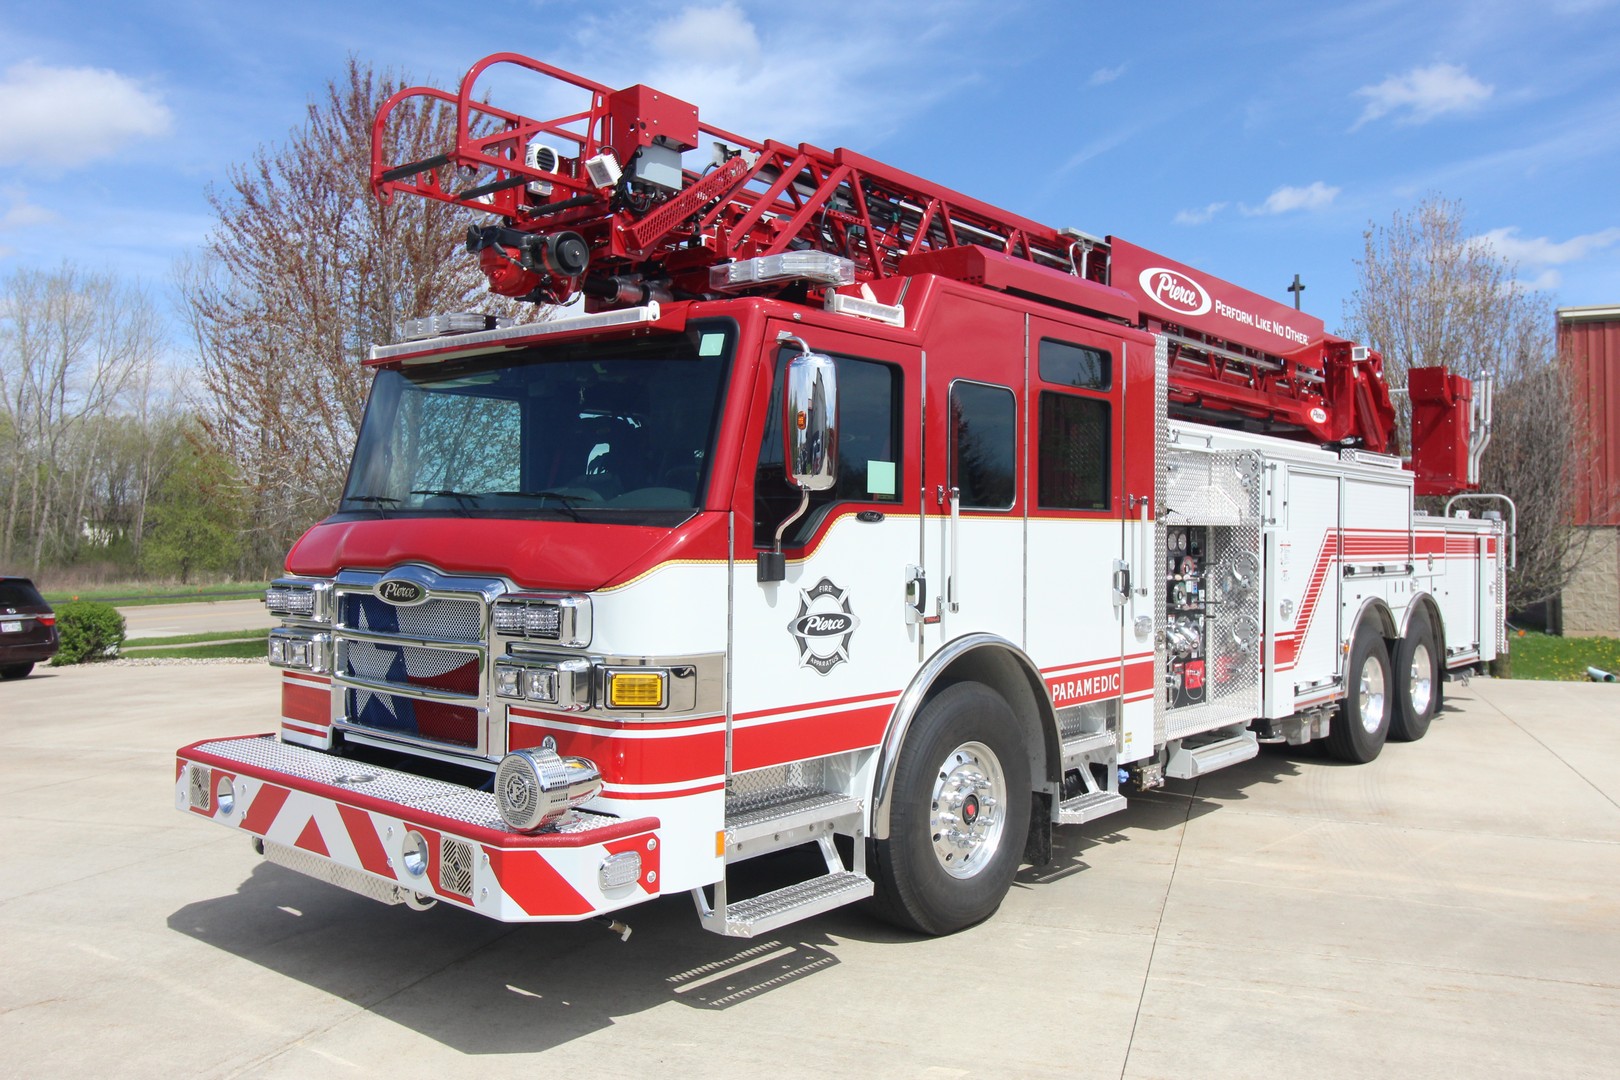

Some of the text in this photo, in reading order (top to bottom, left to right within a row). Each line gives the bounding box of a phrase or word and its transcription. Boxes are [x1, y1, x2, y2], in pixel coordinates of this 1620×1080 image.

[1157, 273, 1197, 307] Pierce
[1255, 314, 1272, 333] LIKE
[1273, 321, 1284, 337] NO
[384, 581, 415, 599] Pierce
[818, 584, 833, 593] FIRE
[803, 616, 845, 635] Pierce
[810, 655, 839, 667] APPARATUS
[1052, 672, 1120, 702] PARAMEDIC
